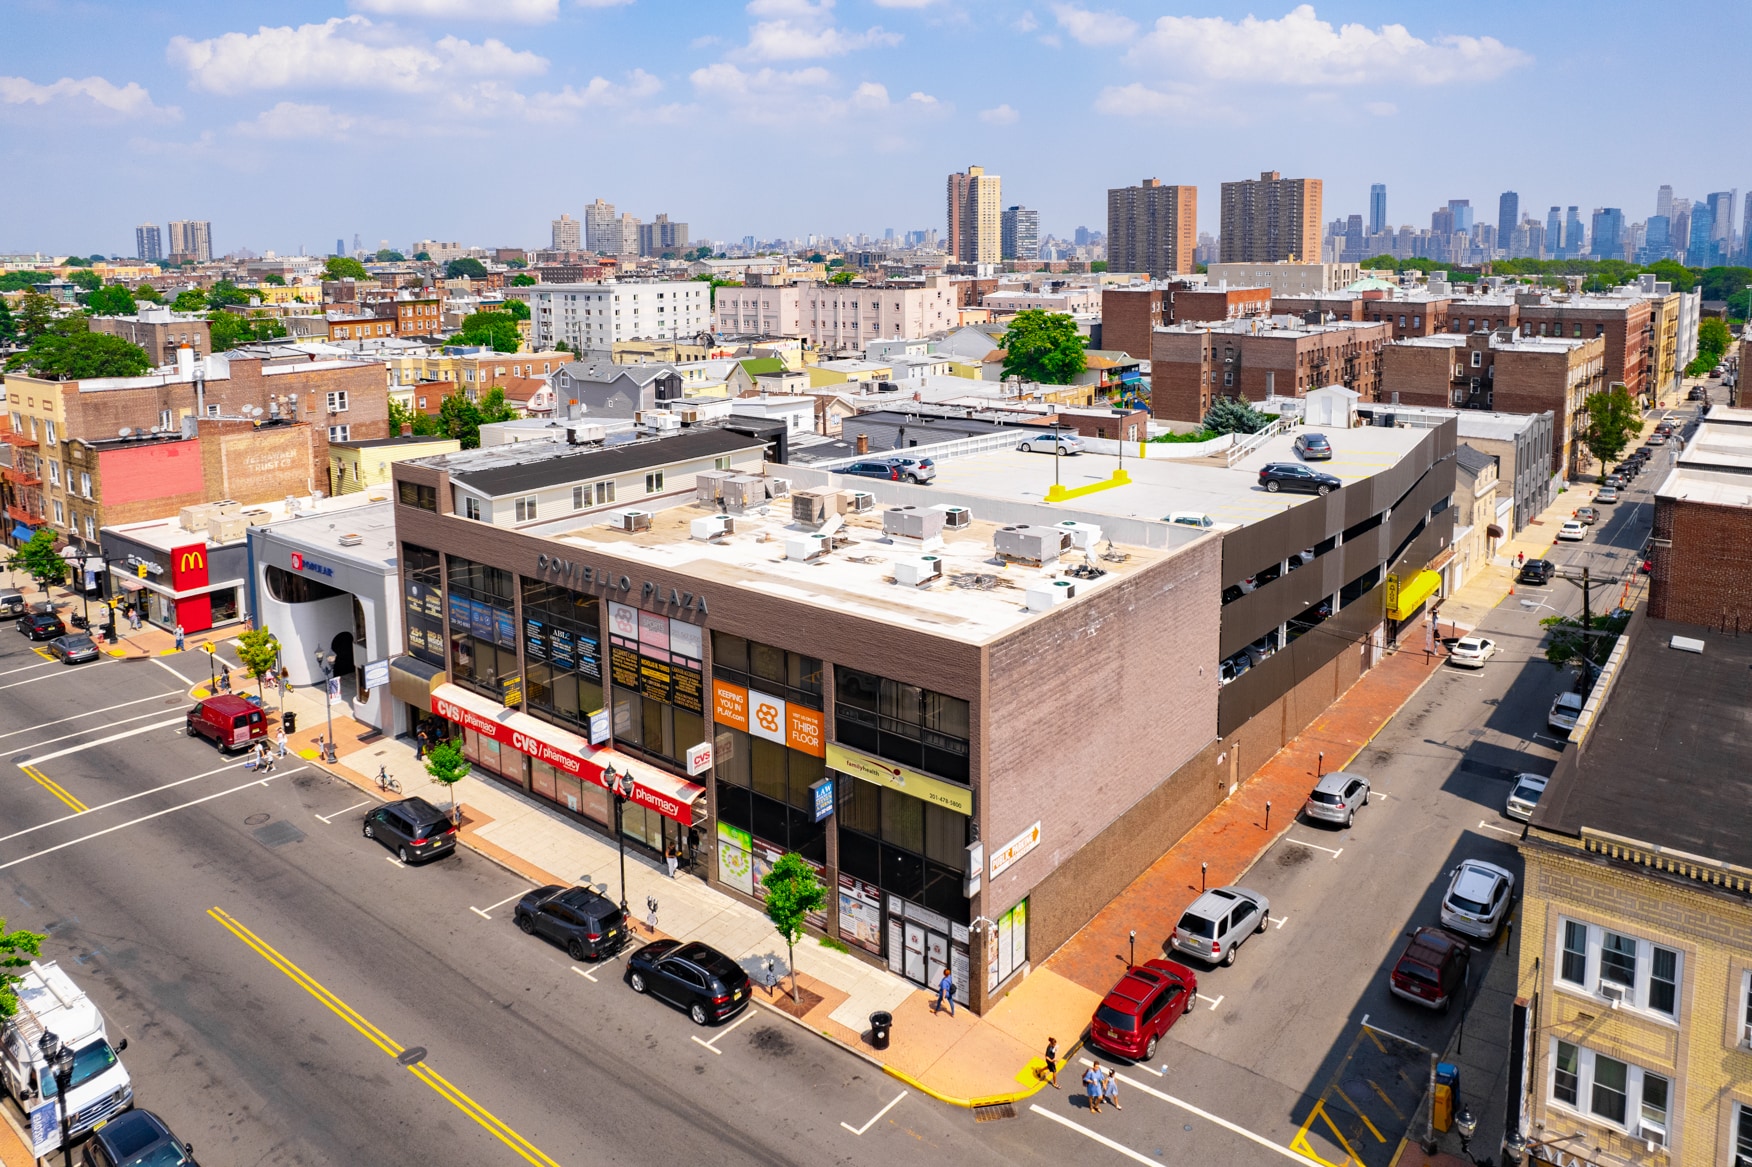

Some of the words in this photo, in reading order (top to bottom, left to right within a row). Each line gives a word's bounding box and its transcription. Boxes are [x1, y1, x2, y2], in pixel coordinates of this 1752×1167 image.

[248, 460, 279, 473] TRUST
[537, 553, 631, 592] COVIELLO
[643, 581, 708, 615] PLAZA
[717, 688, 744, 703] KEEPING
[720, 698, 734, 709] YOU
[734, 703, 742, 712] IN
[717, 706, 745, 722] PLAY.com
[464, 713, 497, 736] pharmacy
[793, 719, 819, 736] THIRD
[792, 731, 819, 748] FLOOR
[543, 747, 580, 772] pharmacy
[694, 751, 710, 765] CVS
[816, 783, 832, 798] LAW
[635, 788, 679, 816] pharmacy
[992, 848, 1011, 872] PUBLIC
[1012, 833, 1032, 857] PARKING
